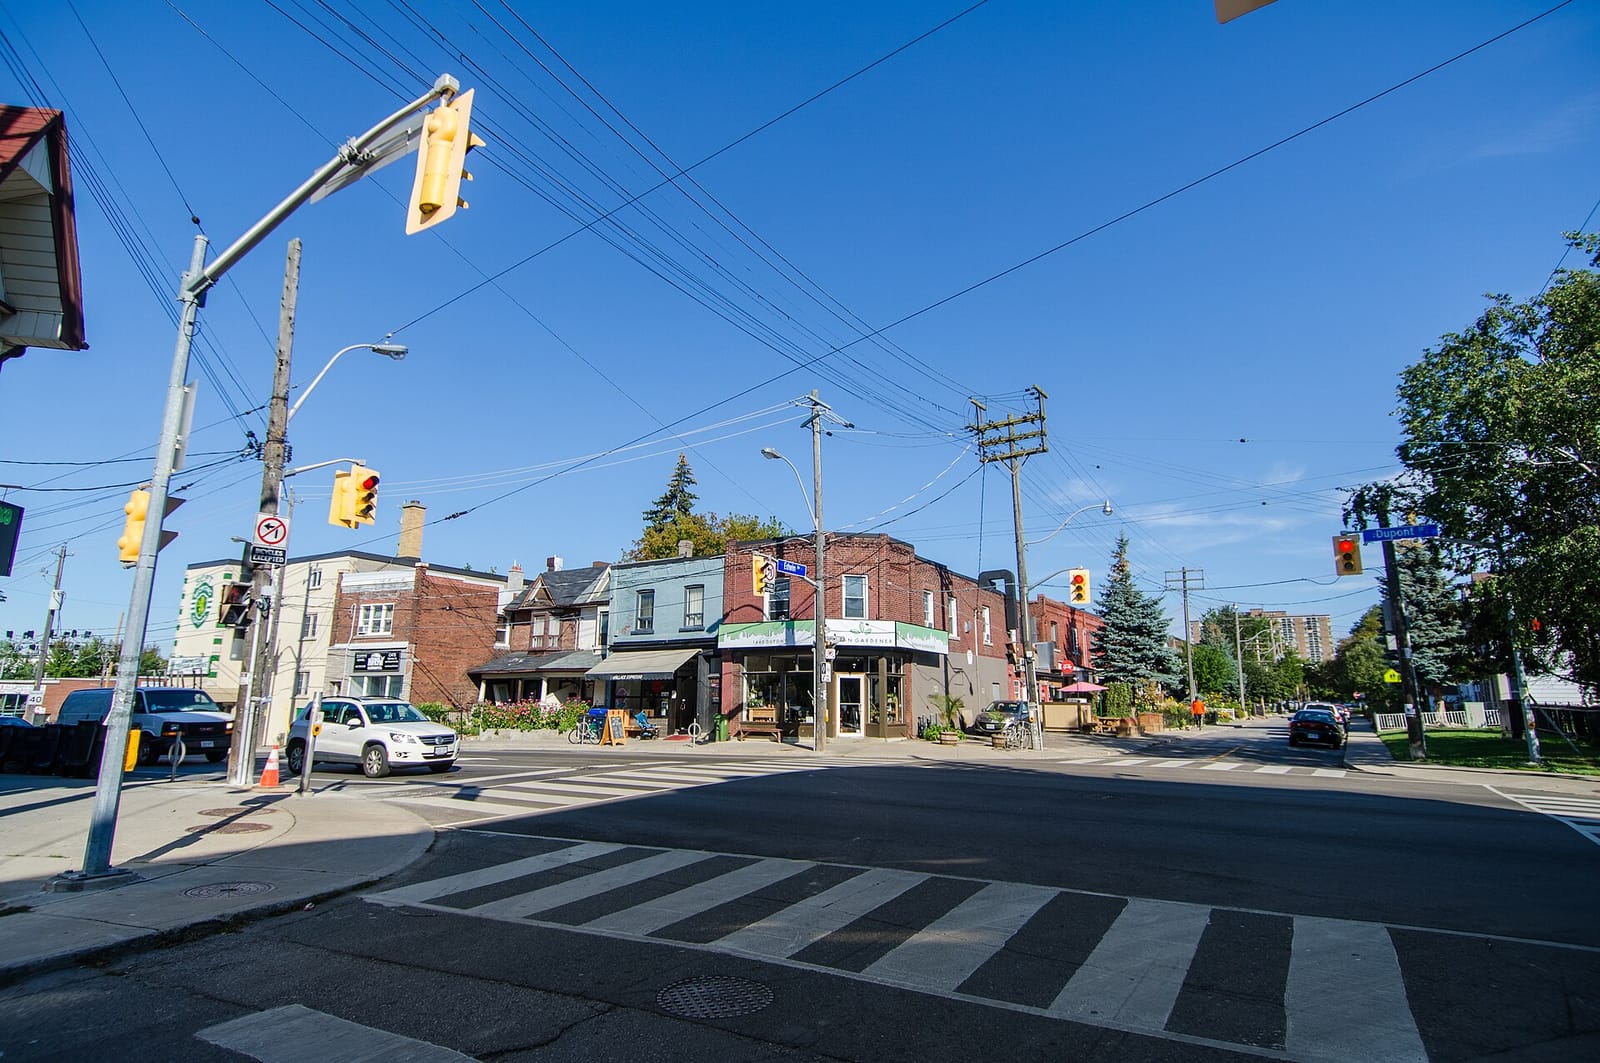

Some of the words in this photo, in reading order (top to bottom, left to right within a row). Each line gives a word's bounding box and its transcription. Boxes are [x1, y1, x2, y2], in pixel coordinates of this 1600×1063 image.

[1375, 524, 1415, 540] Dupont
[254, 548, 284, 556] BICYCLES
[252, 554, 284, 563] EXCEPTED
